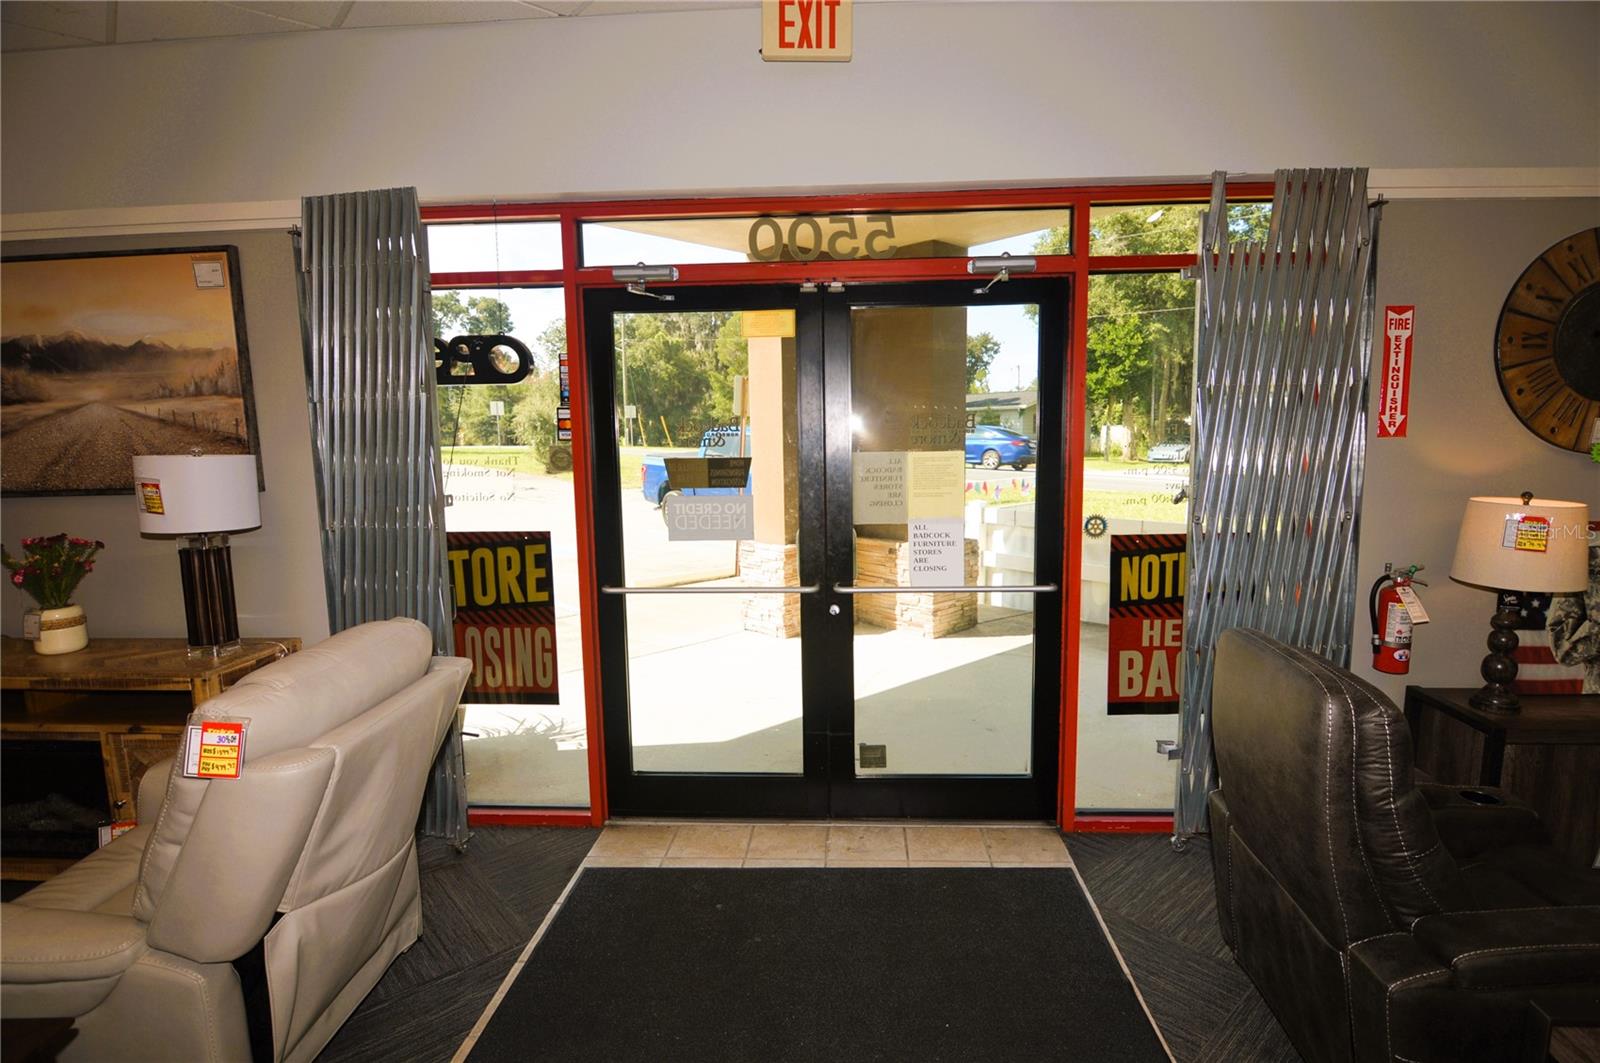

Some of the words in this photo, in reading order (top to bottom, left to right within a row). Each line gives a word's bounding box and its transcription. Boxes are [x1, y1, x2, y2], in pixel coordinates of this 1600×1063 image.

[778, 0, 841, 49] EXIT
[1388, 318, 1411, 331] FIRE
[1388, 334, 1403, 428] EXTINGUISHER
[448, 544, 549, 608] TORE
[1120, 551, 1186, 602] NOTI
[464, 626, 554, 689] OSING
